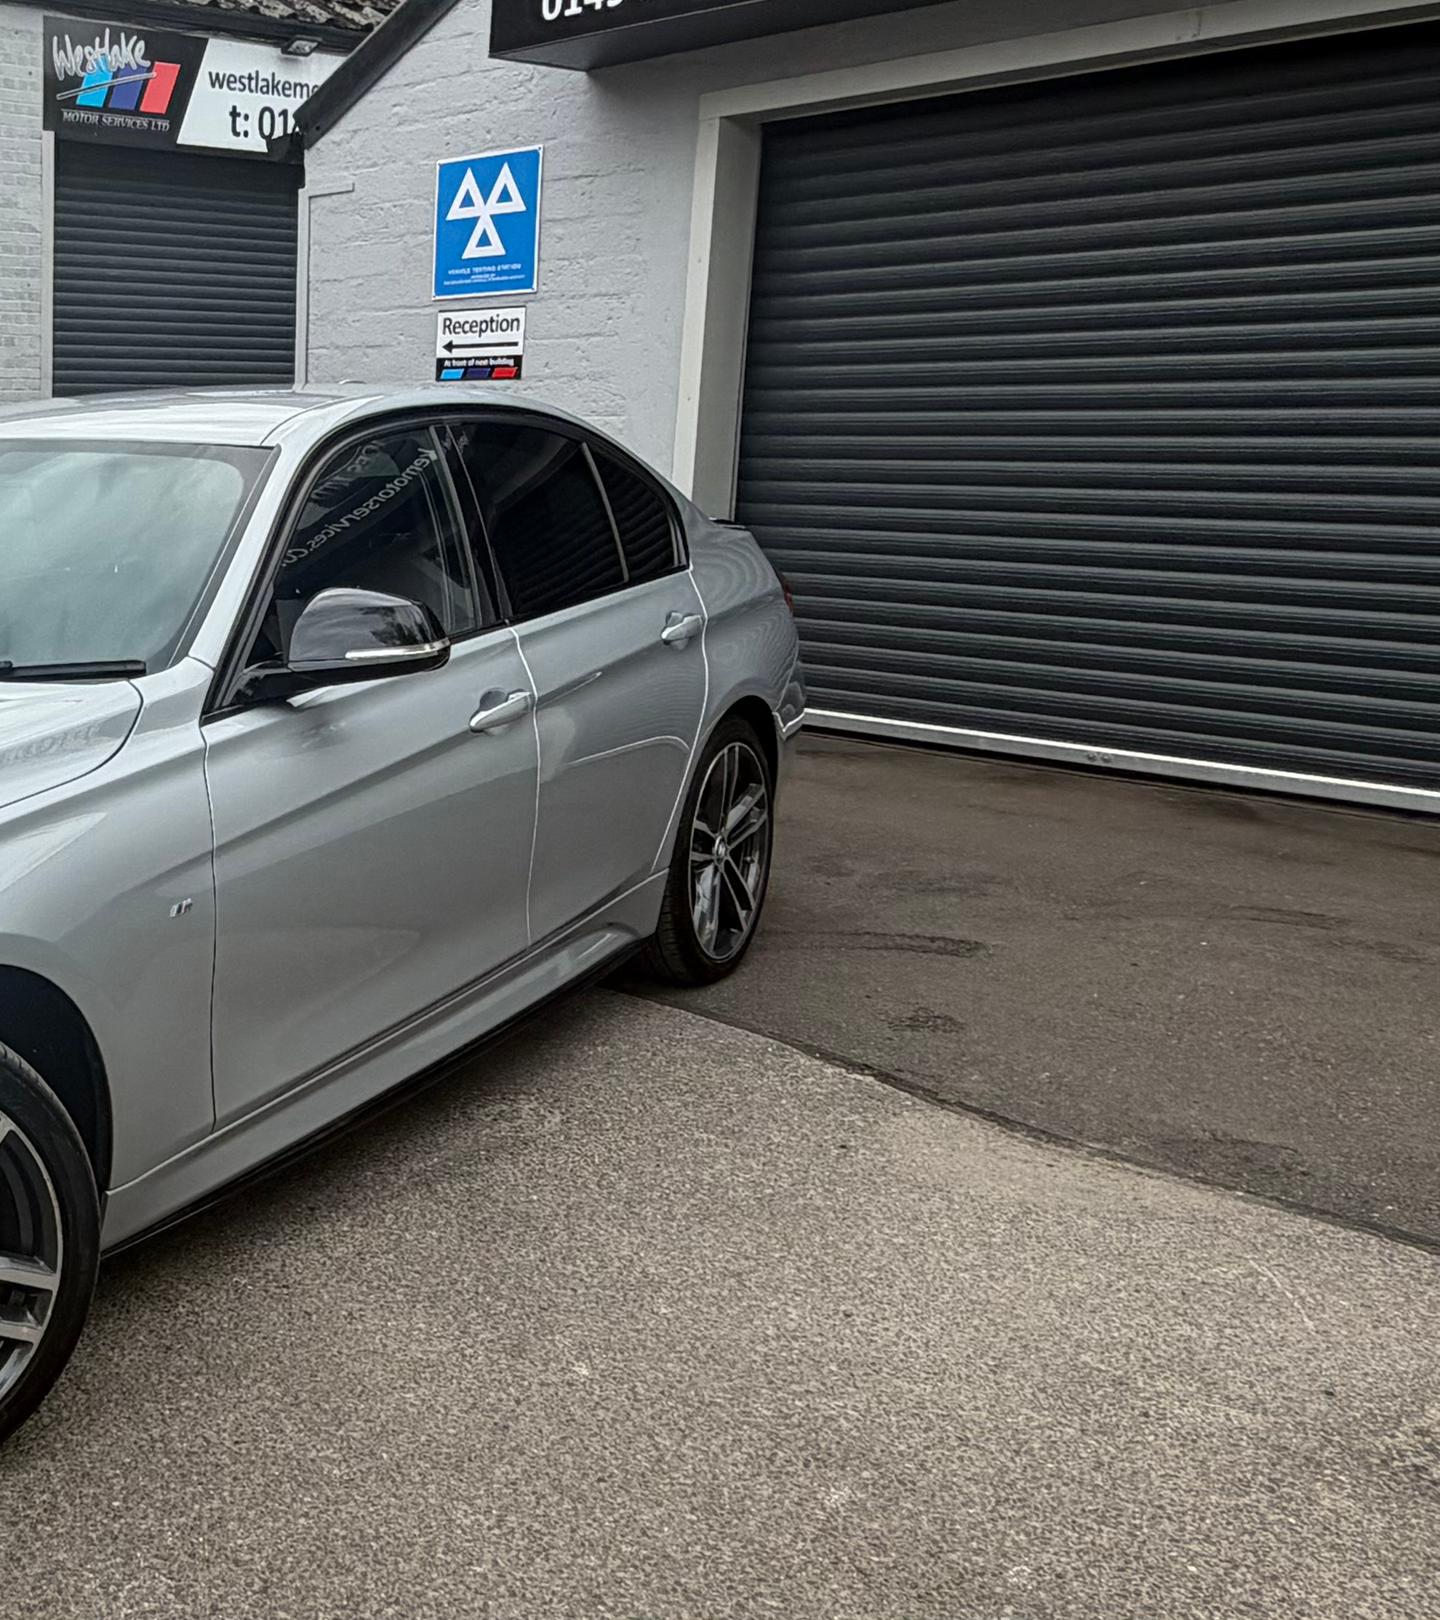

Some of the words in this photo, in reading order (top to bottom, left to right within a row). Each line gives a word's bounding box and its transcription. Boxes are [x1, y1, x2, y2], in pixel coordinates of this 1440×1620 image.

[53, 27, 151, 81] Westlake
[62, 111, 99, 125] MOTOR
[101, 115, 148, 129] SERVICES
[151, 120, 170, 132] LTD
[229, 105, 249, 138] t:
[258, 106, 301, 140] 01
[442, 313, 520, 338] Reception
[452, 359, 467, 367] front
[468, 358, 475, 366] of
[489, 357, 514, 367] building
